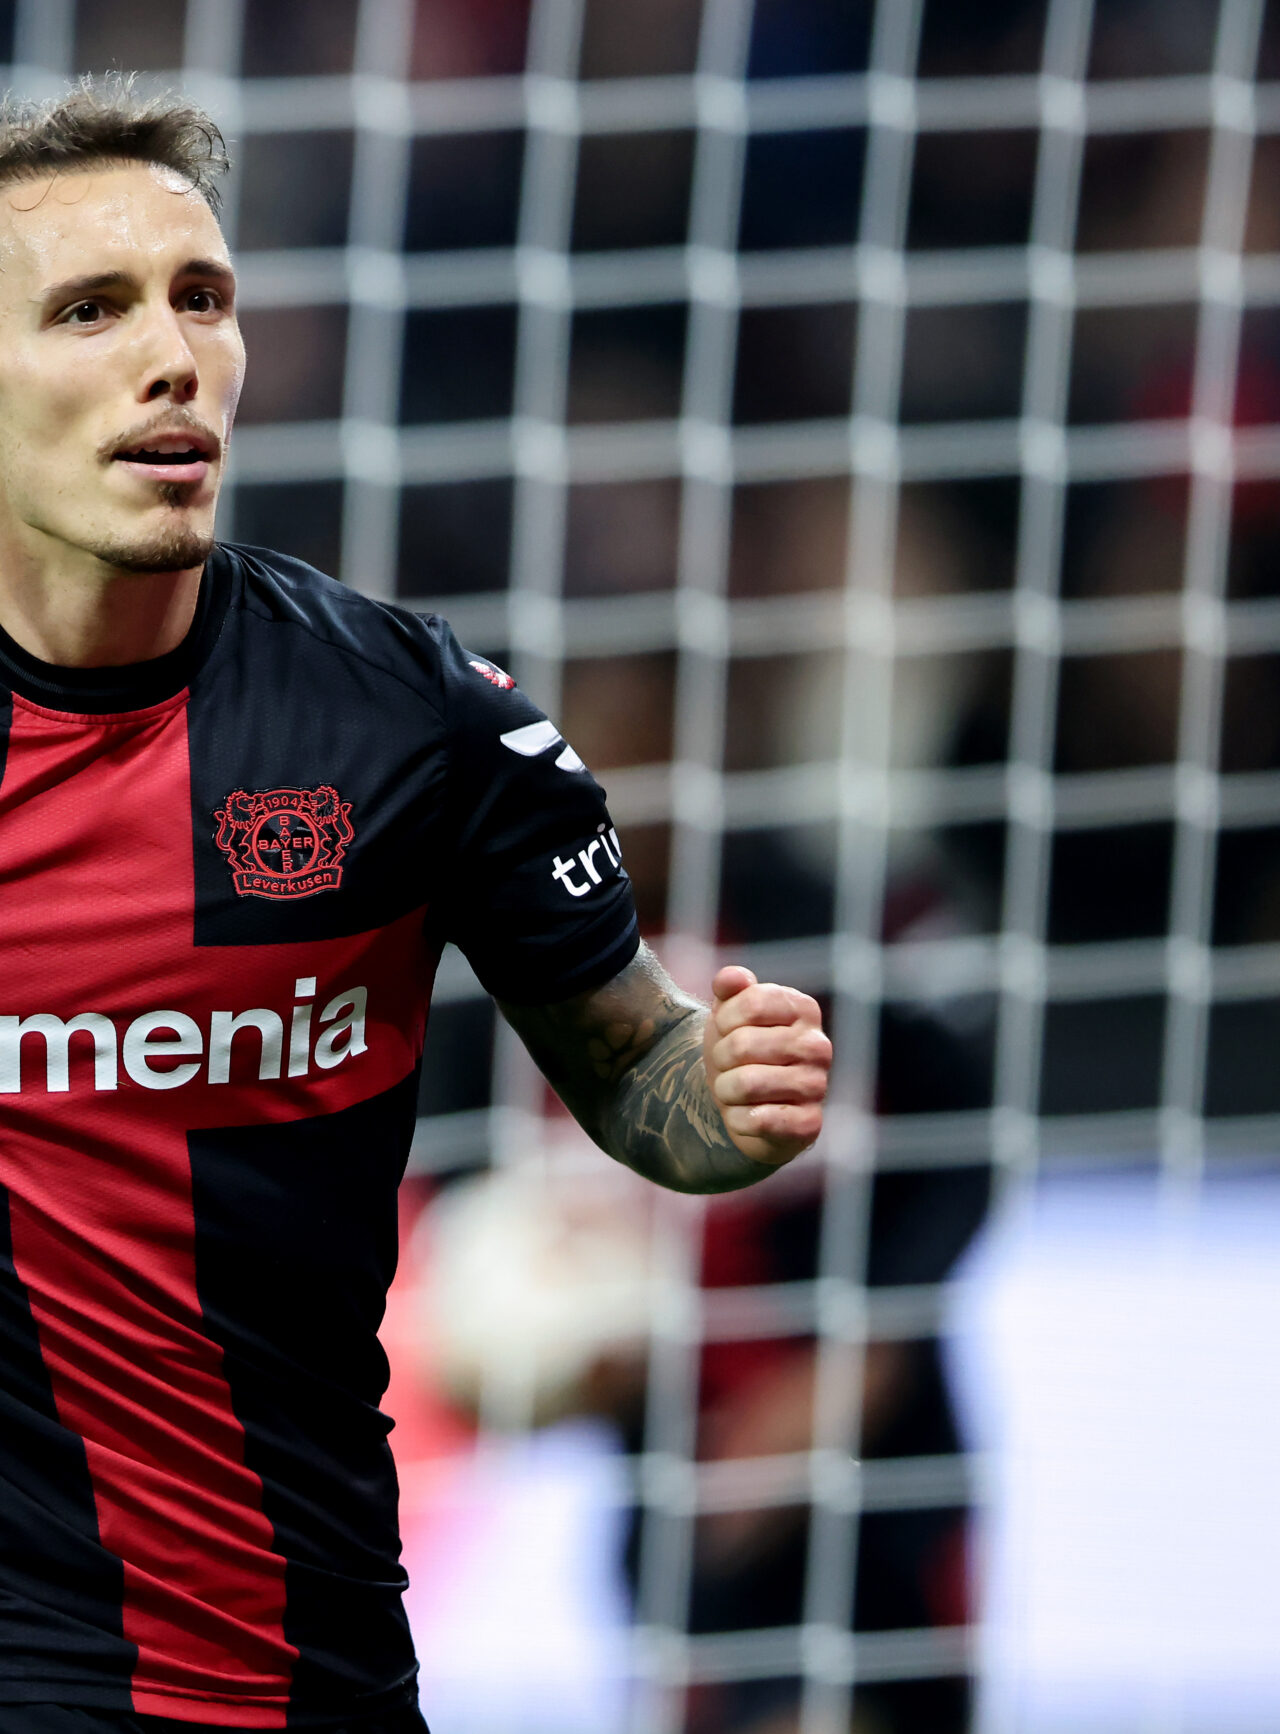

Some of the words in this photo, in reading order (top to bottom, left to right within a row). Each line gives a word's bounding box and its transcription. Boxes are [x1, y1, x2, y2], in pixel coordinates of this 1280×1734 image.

[266, 796, 299, 809] 1904
[258, 836, 314, 851] BAYER
[243, 872, 333, 893] Leverkusen
